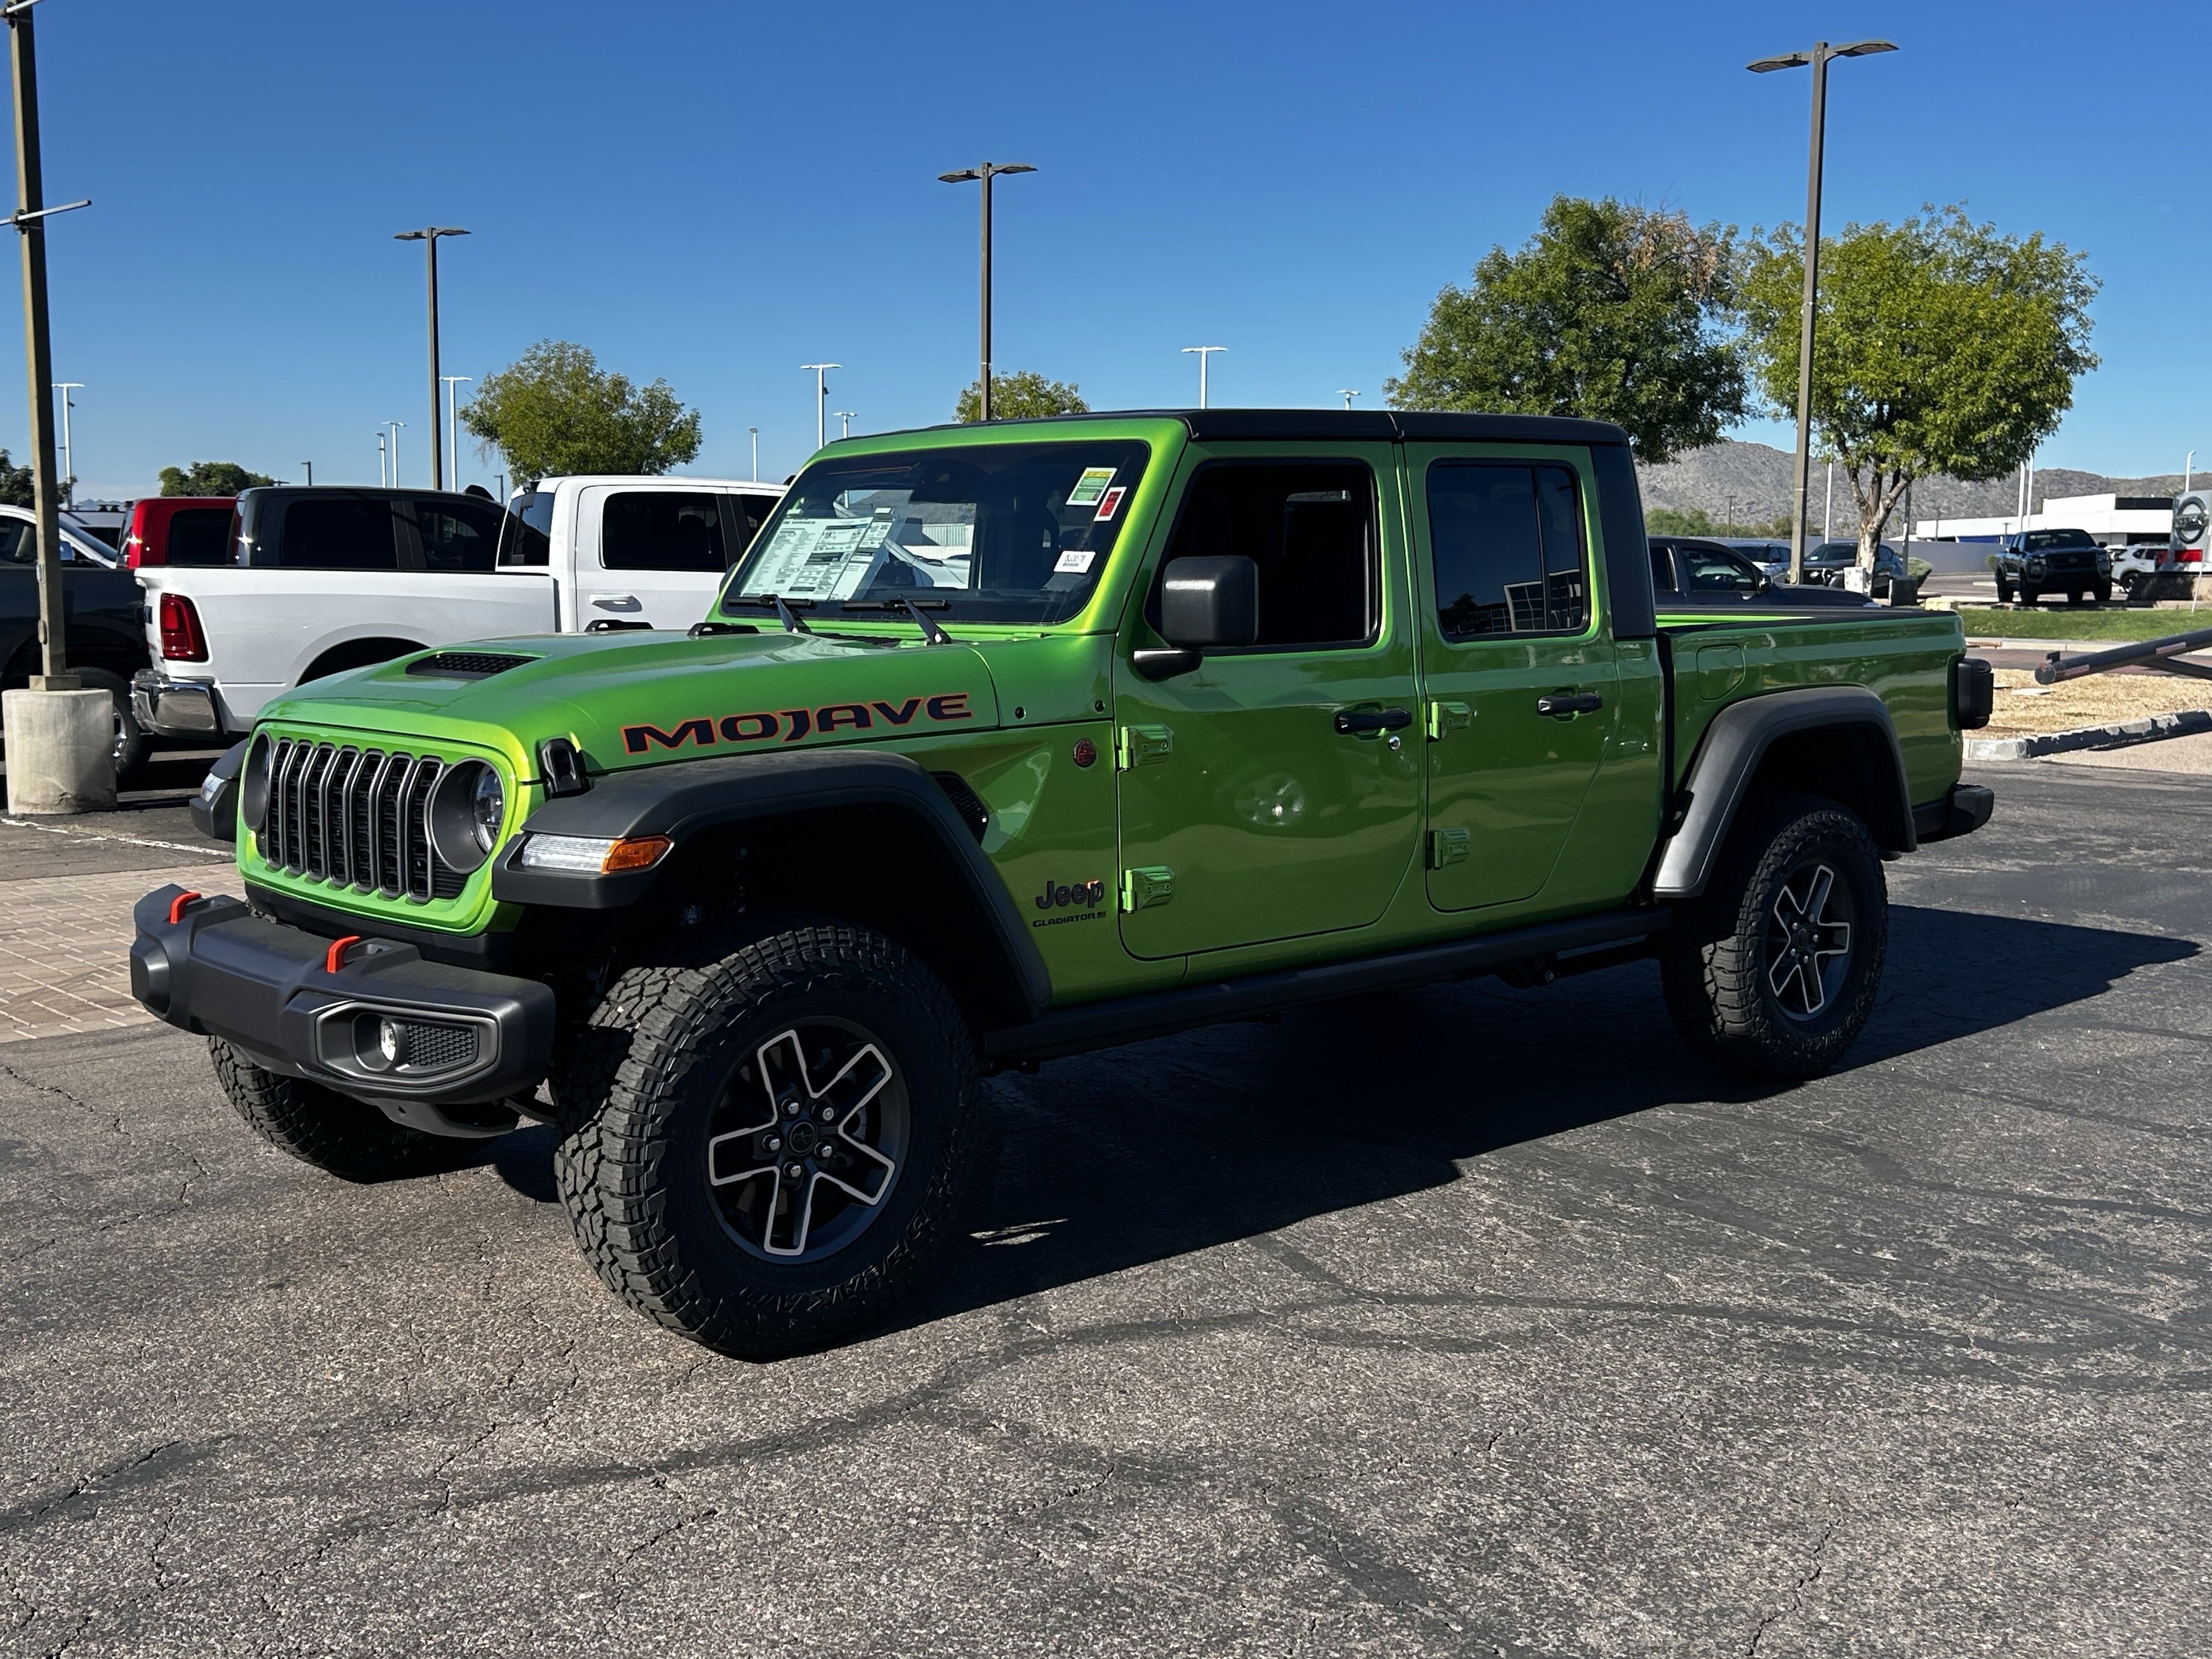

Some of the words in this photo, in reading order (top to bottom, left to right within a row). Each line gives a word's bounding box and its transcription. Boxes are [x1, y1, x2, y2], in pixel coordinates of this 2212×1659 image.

[620, 692, 973, 754] MOJAVE
[1036, 880, 1104, 909] Jeep
[1032, 912, 1095, 928] GLADIATOR
